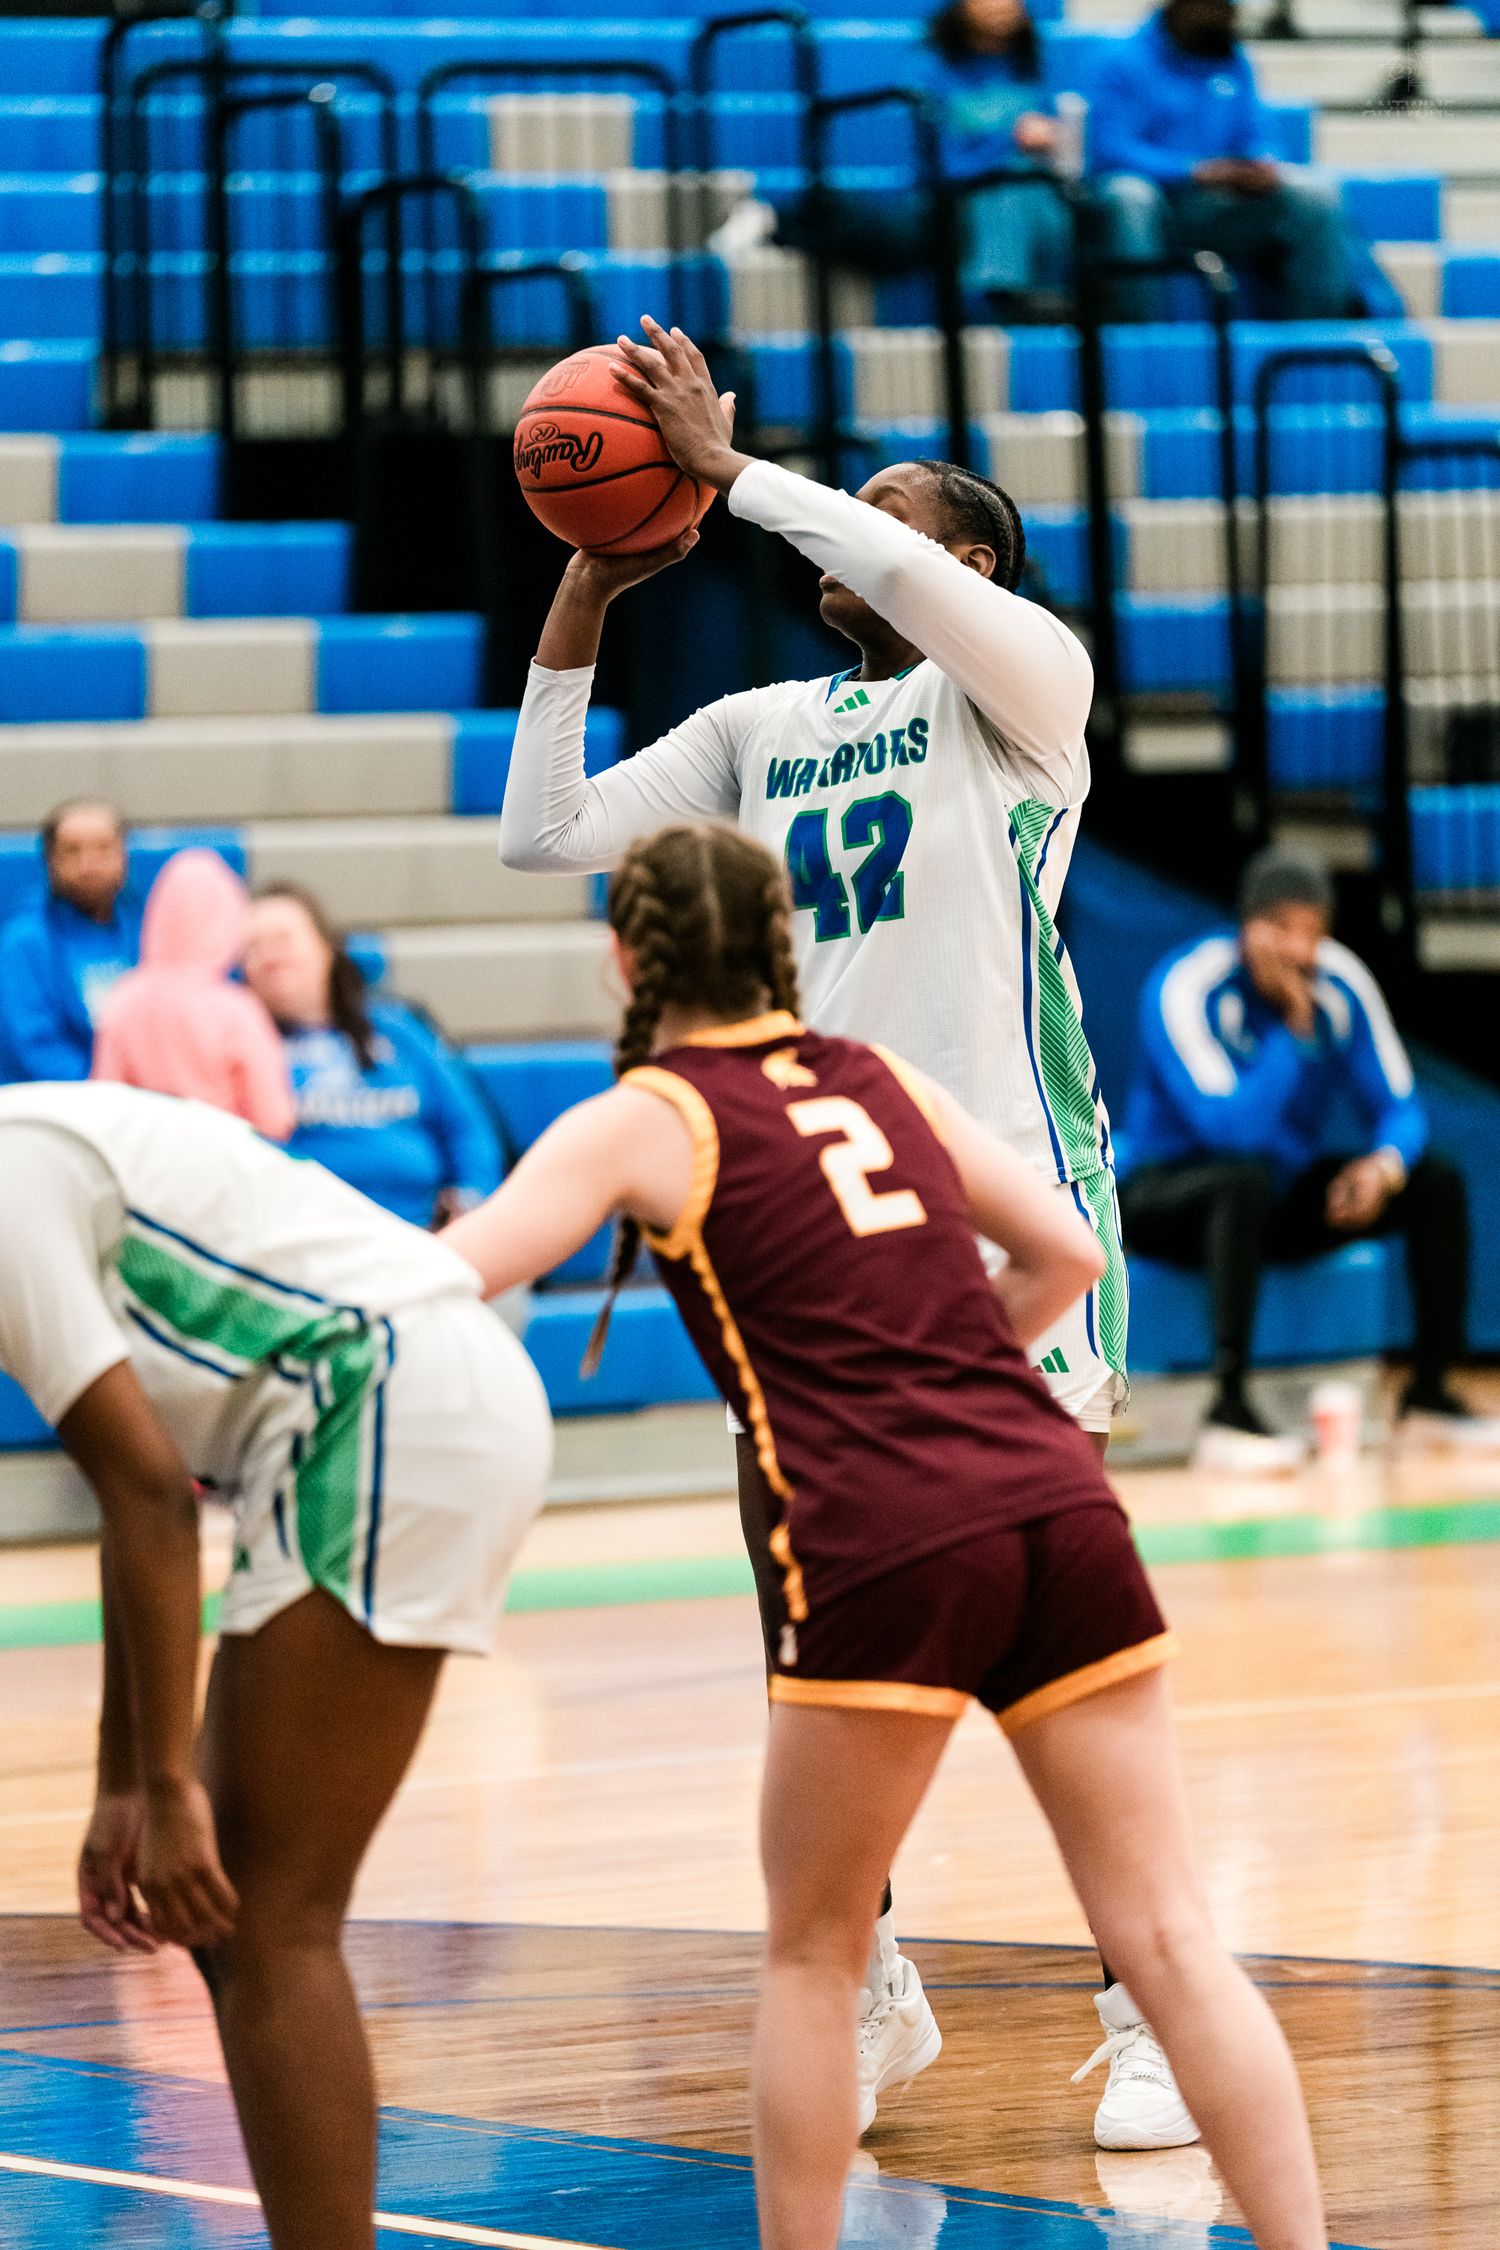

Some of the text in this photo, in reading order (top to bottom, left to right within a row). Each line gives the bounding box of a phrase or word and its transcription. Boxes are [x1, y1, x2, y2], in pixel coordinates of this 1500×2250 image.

[515, 431, 604, 480] Rawling
[784, 790, 914, 942] 42
[785, 1095, 929, 1239] 2
